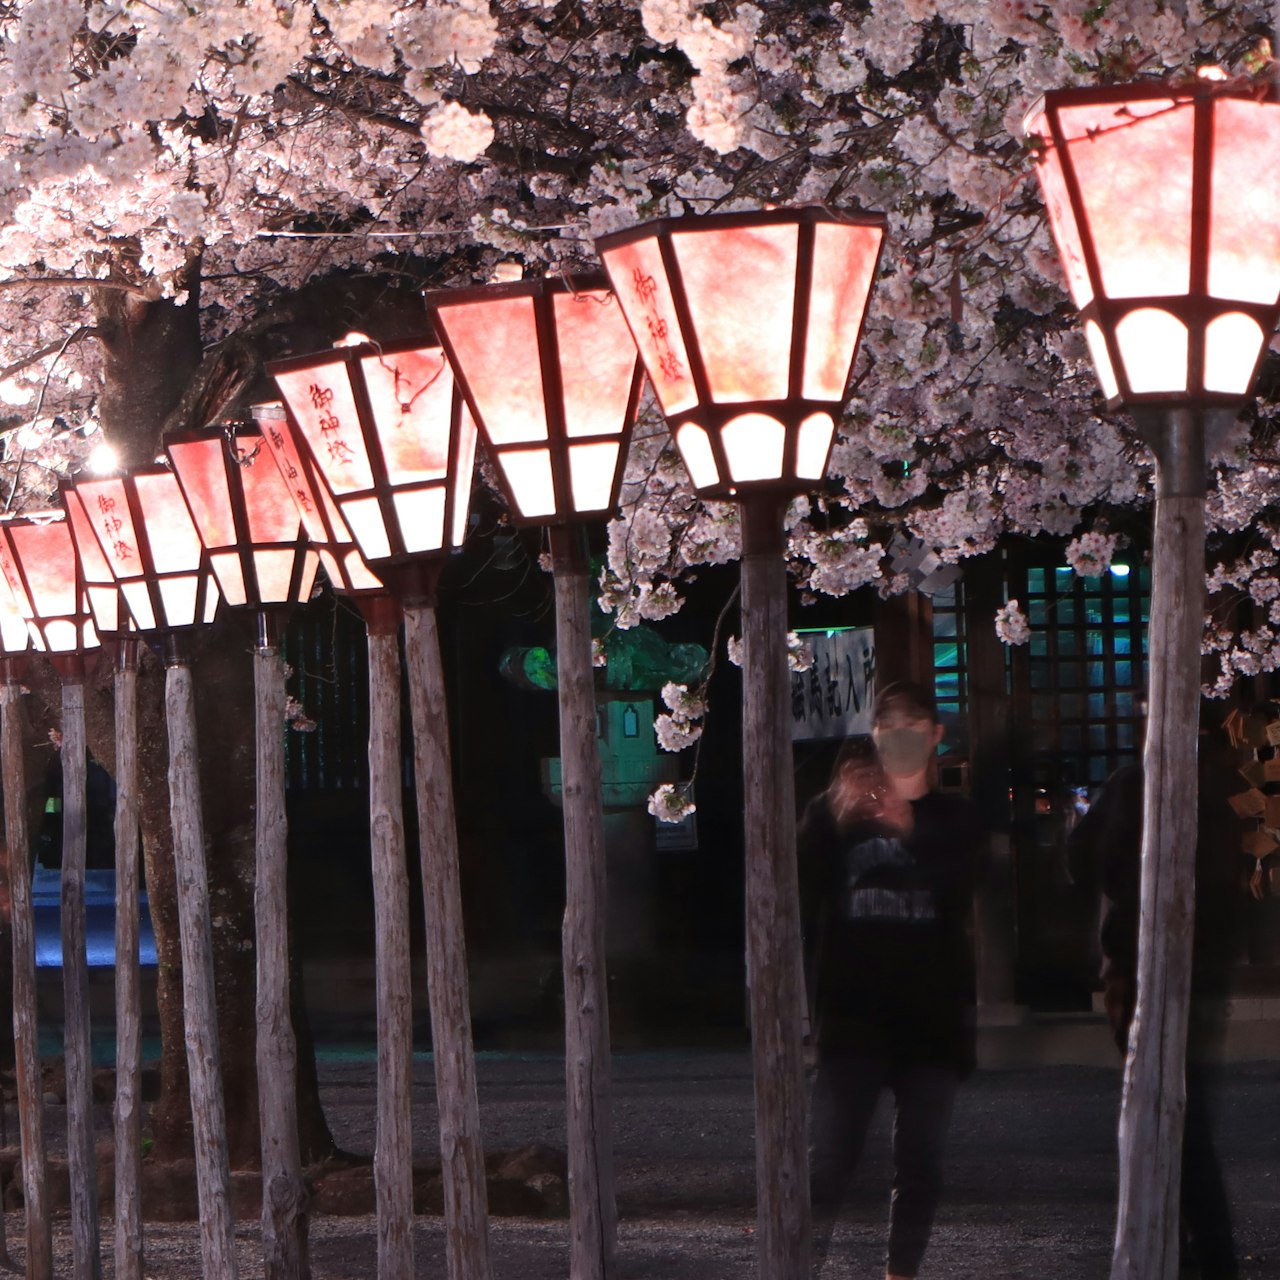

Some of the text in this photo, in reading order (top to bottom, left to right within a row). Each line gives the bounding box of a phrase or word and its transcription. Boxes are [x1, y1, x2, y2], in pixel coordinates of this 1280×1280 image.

[633, 267, 684, 382] 御神燈
[309, 383, 355, 467] 御神燈
[97, 494, 133, 560] 御神燈
